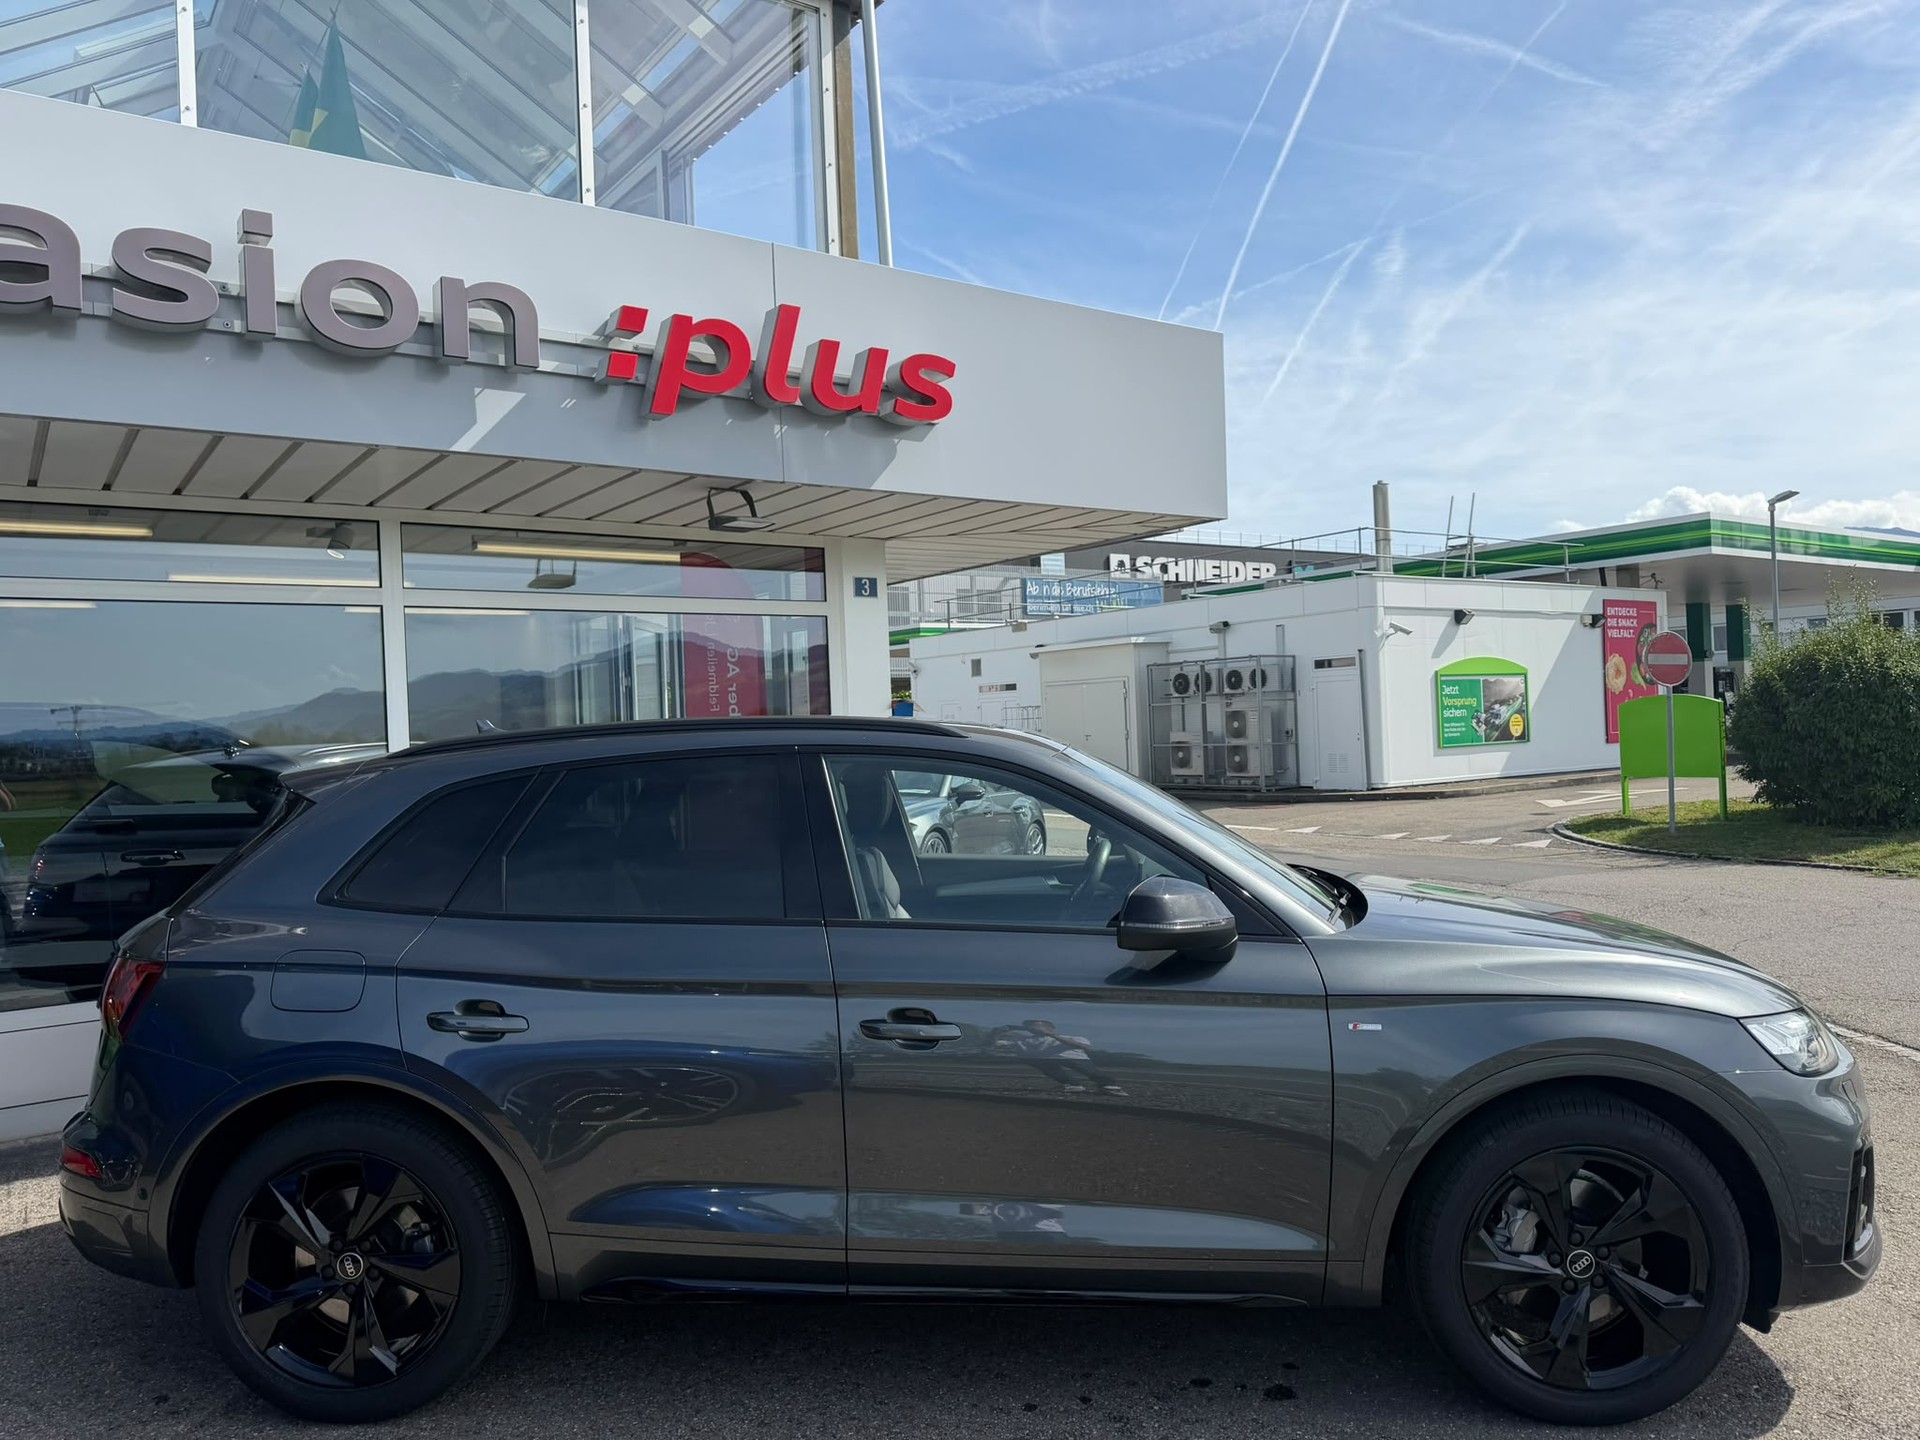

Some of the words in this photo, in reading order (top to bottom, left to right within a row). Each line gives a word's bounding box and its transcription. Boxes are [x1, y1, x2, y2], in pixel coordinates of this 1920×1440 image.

[1136, 556, 1277, 583] SCHNEIDER
[862, 579, 870, 596] 3
[1026, 580, 1040, 596] Ab
[1607, 607, 1637, 616] ENTDECKE
[1607, 618, 1617, 627] DIE
[1618, 618, 1638, 628] SNACK
[1442, 685, 1459, 695] Jetzt
[1442, 696, 1477, 707] Vorsprung
[1443, 707, 1467, 717] sichern
